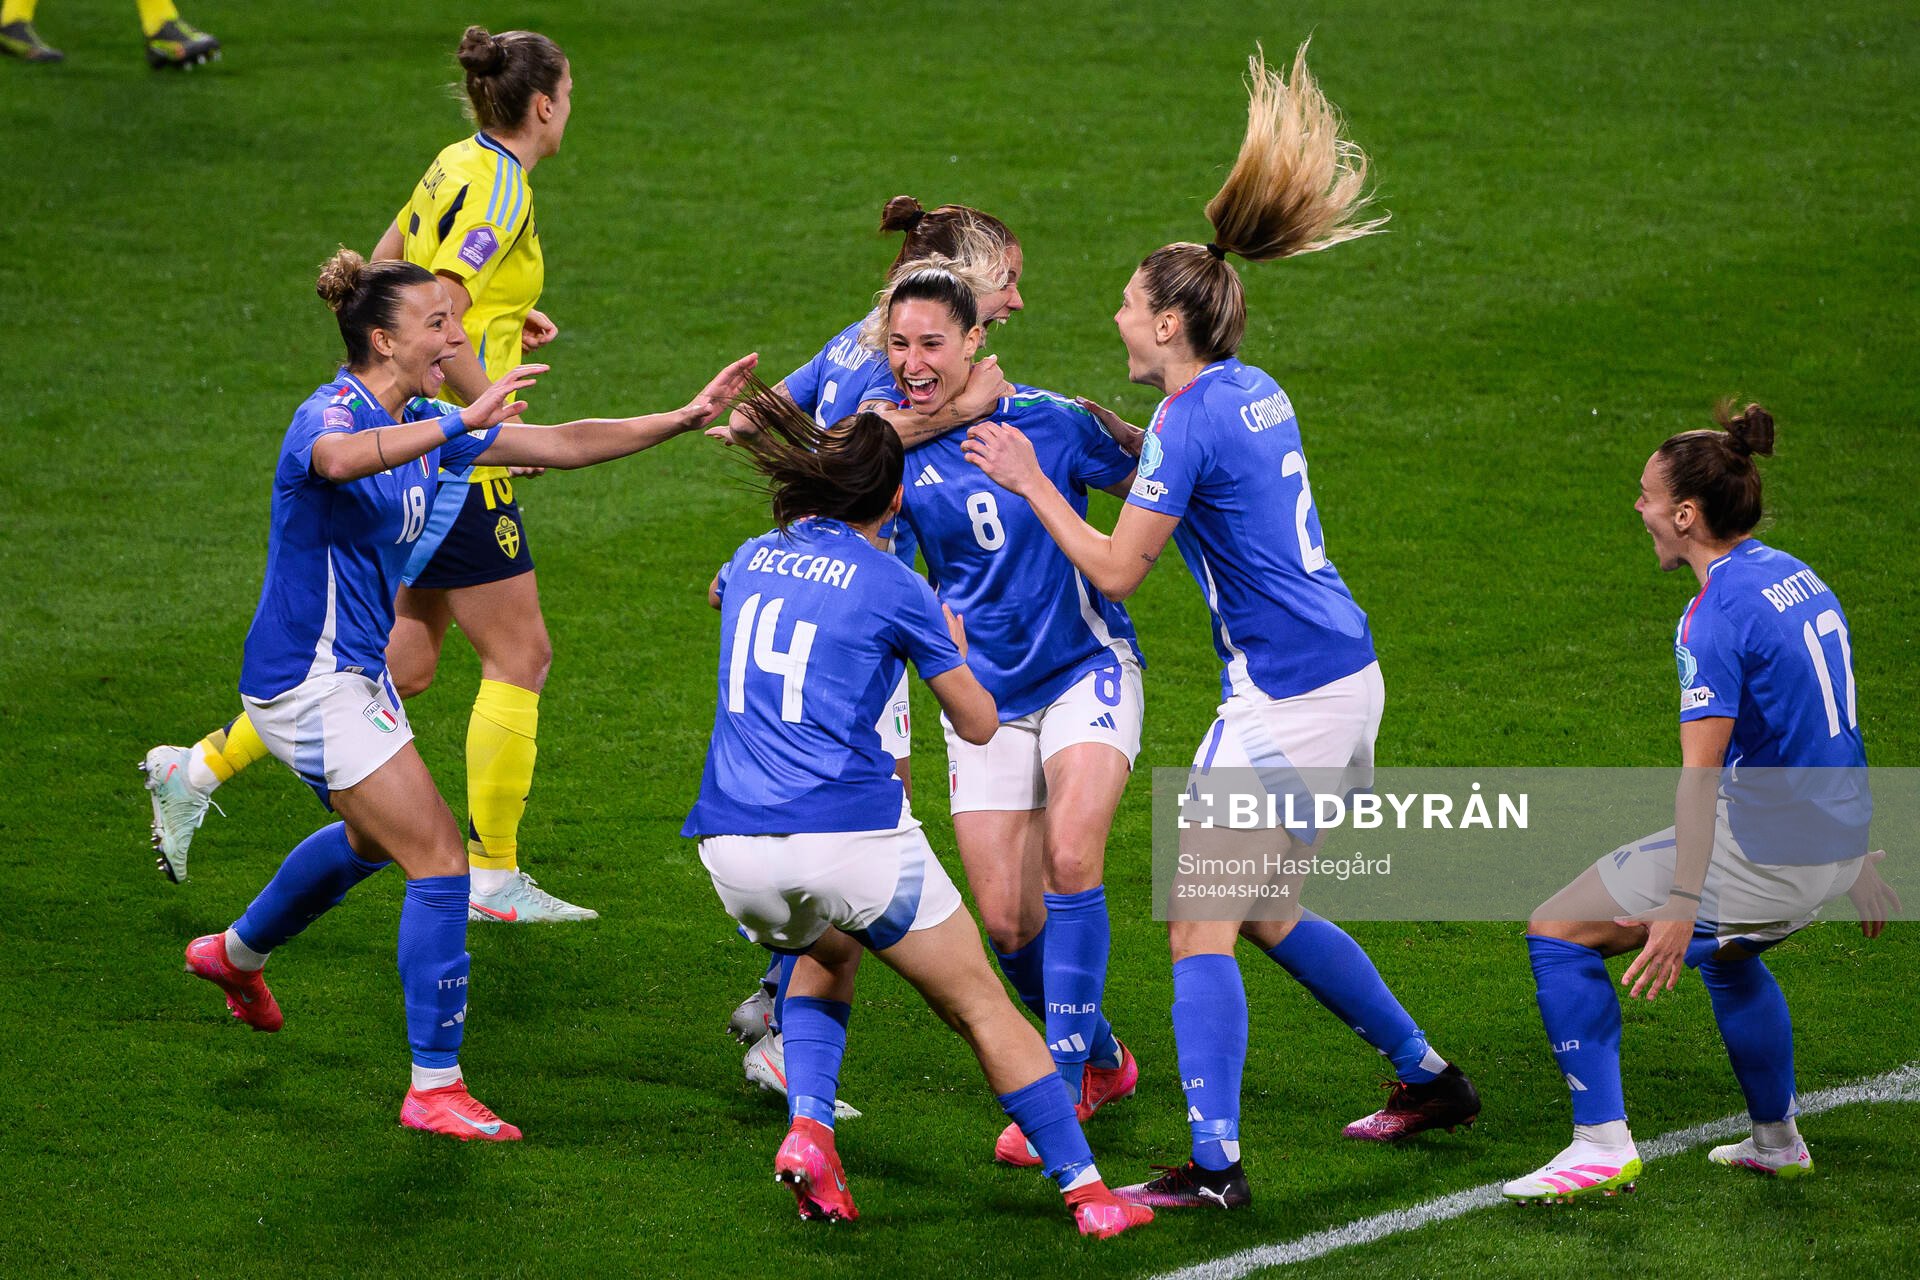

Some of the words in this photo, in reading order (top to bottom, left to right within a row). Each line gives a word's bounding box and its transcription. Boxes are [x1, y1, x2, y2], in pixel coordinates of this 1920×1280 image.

[395, 486, 426, 544] 18
[966, 491, 1006, 551] 8
[1281, 450, 1326, 574] 2
[747, 546, 858, 590] BECCARI
[728, 592, 818, 724] 14
[1094, 663, 1123, 707] 8
[1803, 609, 1857, 739] 17
[1048, 1002, 1096, 1014] ITALIA
